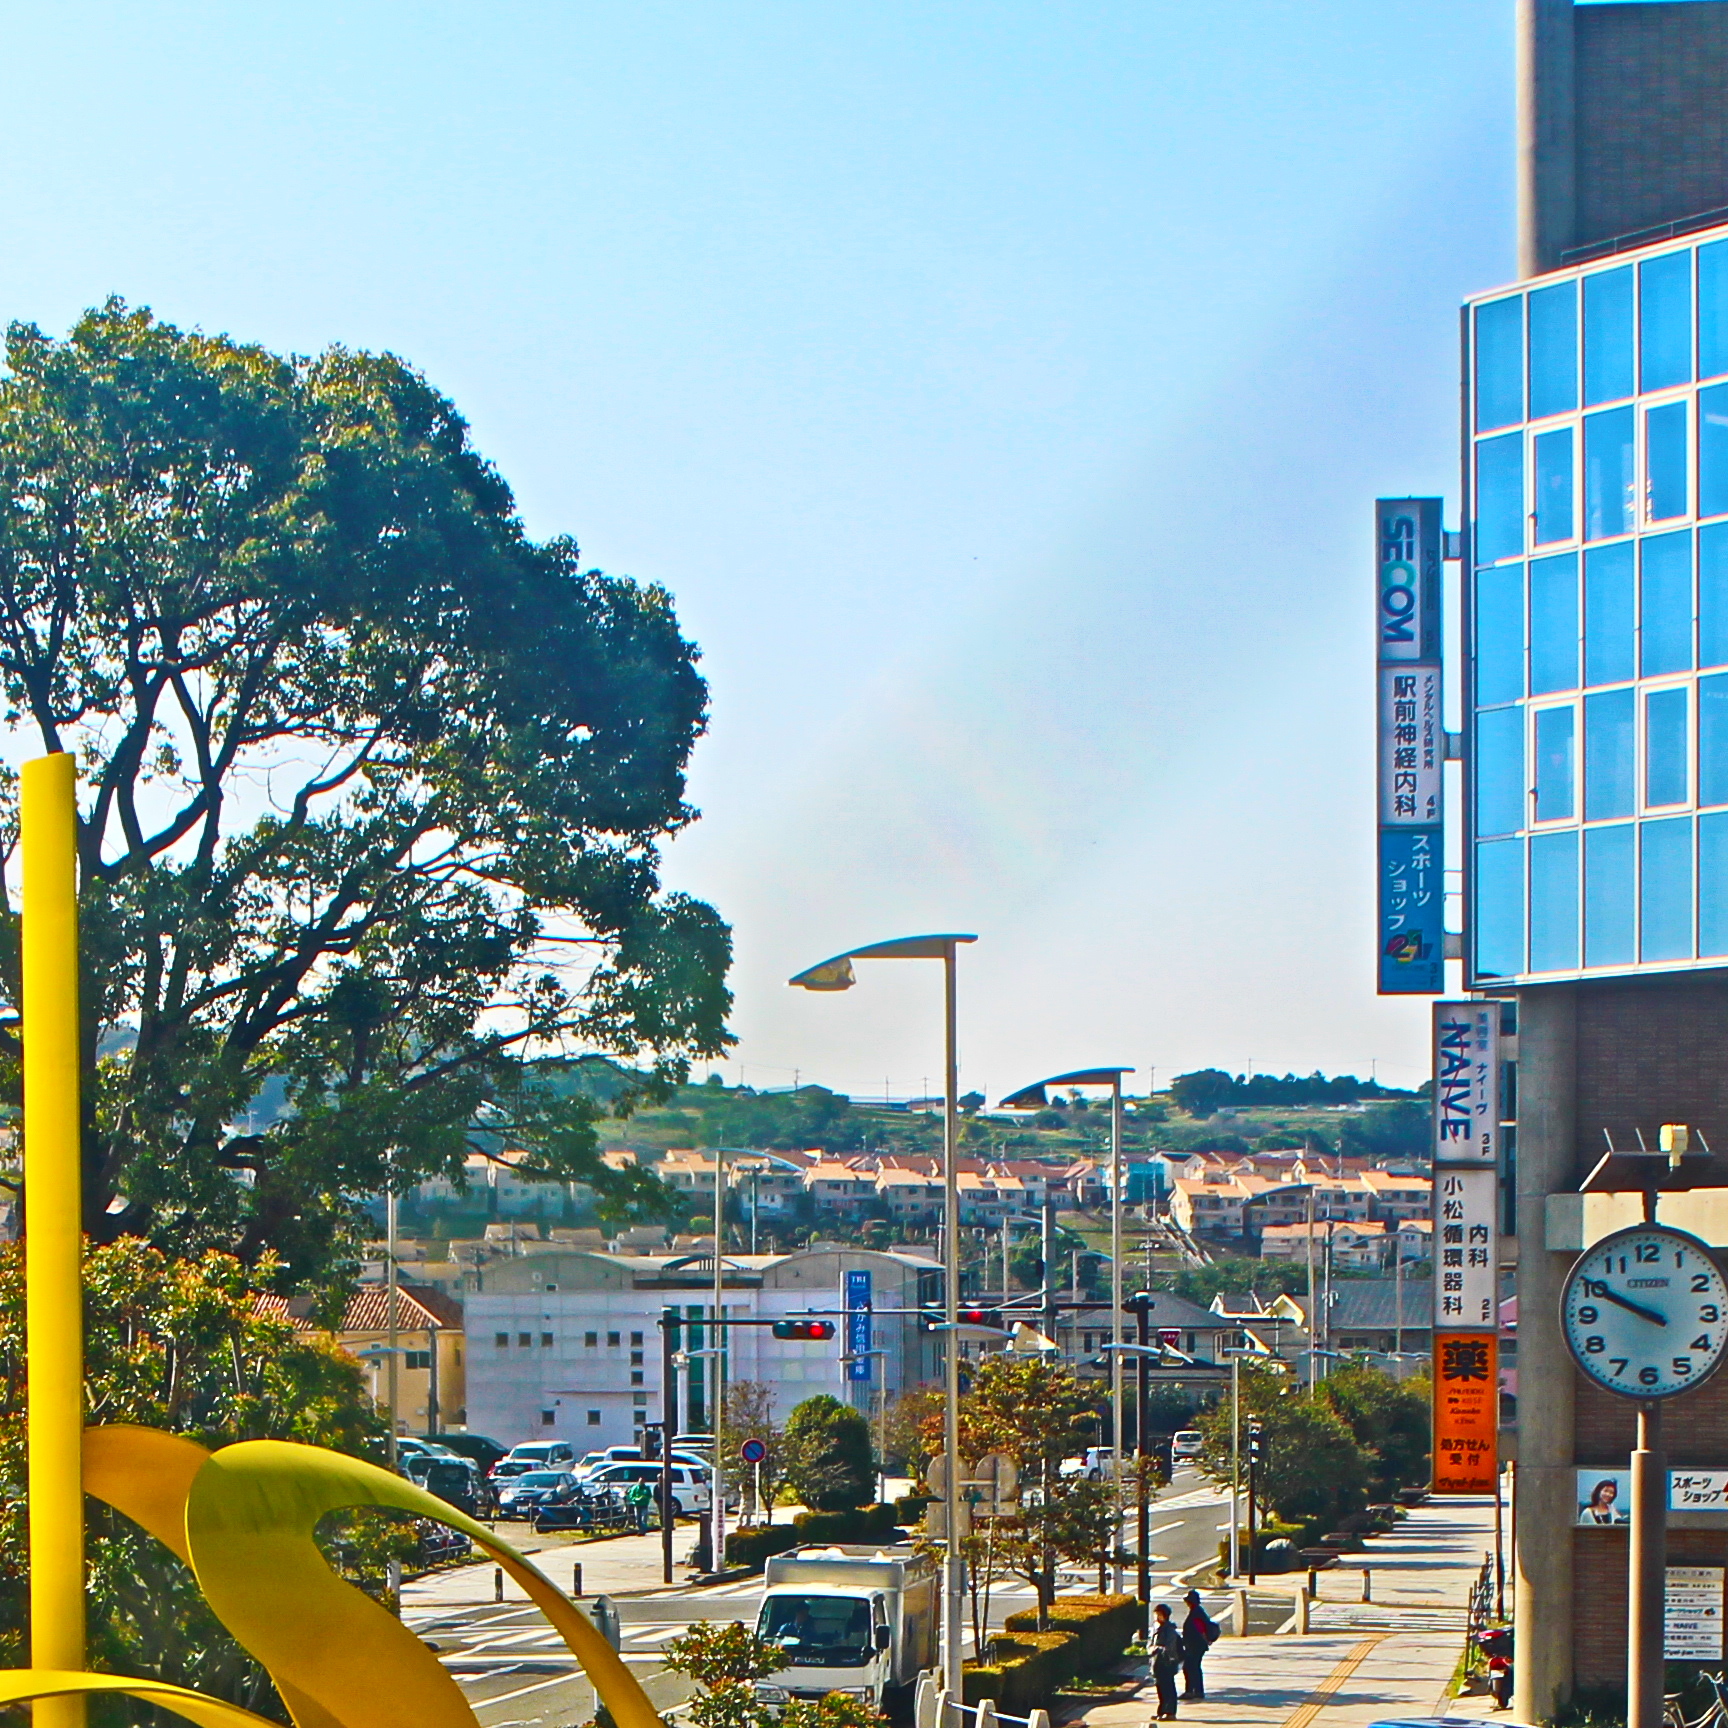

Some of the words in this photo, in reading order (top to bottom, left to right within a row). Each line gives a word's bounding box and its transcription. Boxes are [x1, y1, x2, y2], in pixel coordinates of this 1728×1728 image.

[1382, 516, 1414, 642] SECOM
[1393, 675, 1417, 818] 駅前神経内科
[1440, 1022, 1471, 1141] NAIVE
[1481, 1132, 1491, 1157] 3F
[1443, 1176, 1464, 1316] 小松循環器科
[1468, 1223, 1489, 1268] 内科
[1634, 1243, 1660, 1263] 12
[1604, 1256, 1626, 1274] 11
[1674, 1251, 1683, 1269] 1
[1582, 1279, 1608, 1298] 10
[1626, 1277, 1670, 1289] CITIZEN
[1691, 1274, 1710, 1293] 2
[1481, 1298, 1491, 1321] 2F
[1578, 1306, 1599, 1325] 9
[1699, 1304, 1719, 1323] 3
[1585, 1335, 1606, 1354] 8
[1689, 1334, 1712, 1352] 4
[1442, 1340, 1489, 1382] 薬
[1608, 1357, 1629, 1376] 7
[1672, 1356, 1692, 1375] 5
[1638, 1366, 1660, 1386] 6
[1440, 1438, 1490, 1451] 処方せん
[1449, 1453, 1481, 1467] 受付
[1672, 1476, 1712, 1489] スポーツ
